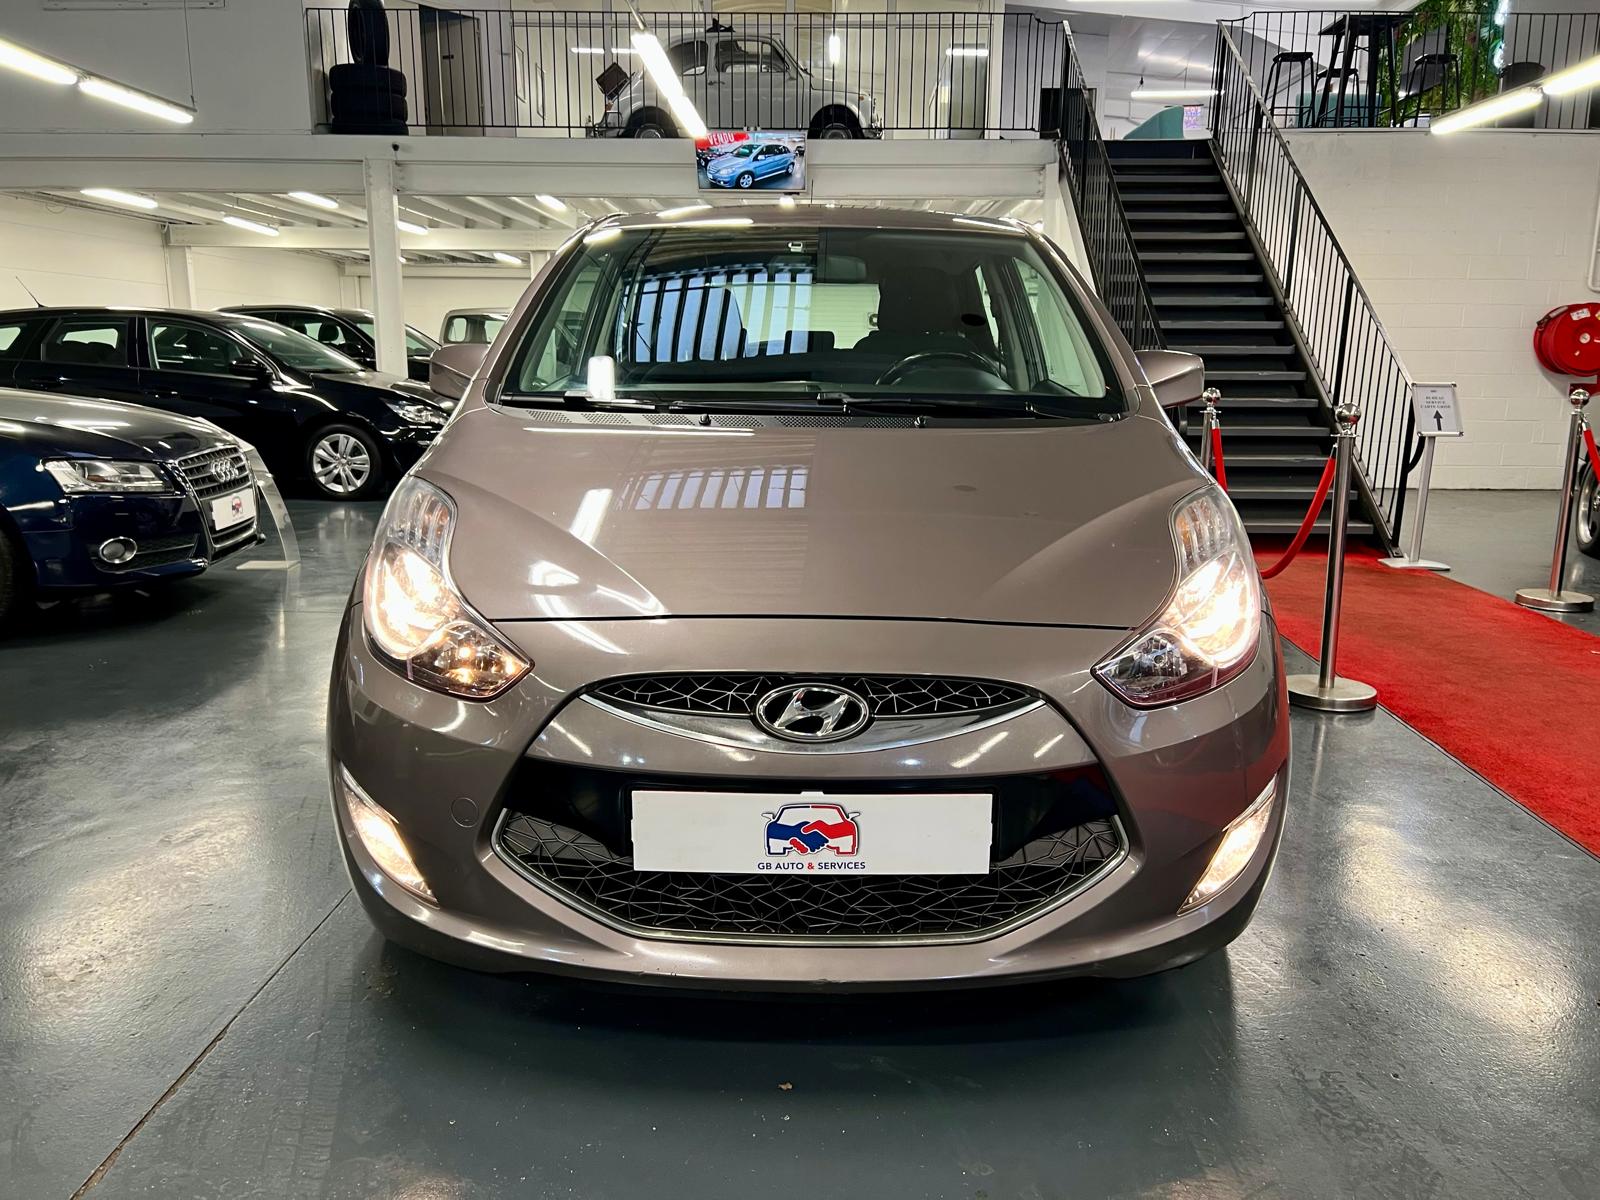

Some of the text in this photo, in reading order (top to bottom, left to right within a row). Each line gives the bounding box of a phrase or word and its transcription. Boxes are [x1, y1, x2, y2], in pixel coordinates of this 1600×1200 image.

[707, 132, 734, 145] VENDU
[757, 861, 866, 870] GB AUTO & SERVICES
